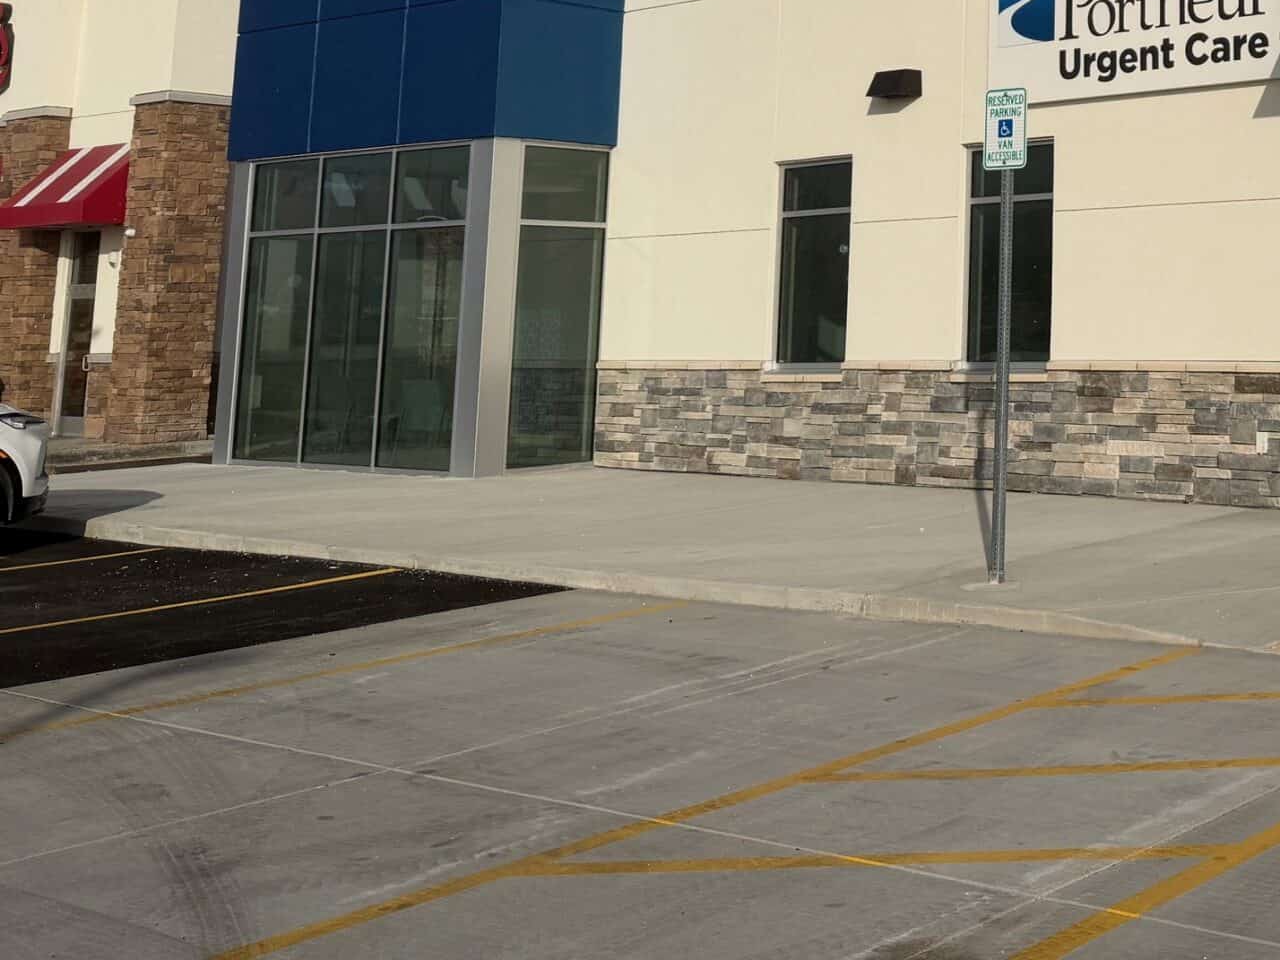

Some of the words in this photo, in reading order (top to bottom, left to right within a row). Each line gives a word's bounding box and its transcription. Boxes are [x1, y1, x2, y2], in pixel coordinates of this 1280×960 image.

[1059, 38, 1175, 83] Urgent
[1185, 32, 1270, 66] Care
[988, 94, 1024, 107] RESERVED
[990, 106, 1022, 118] PARKING
[998, 140, 1013, 150] VAN
[987, 151, 1024, 162] ACCESSIBLE
